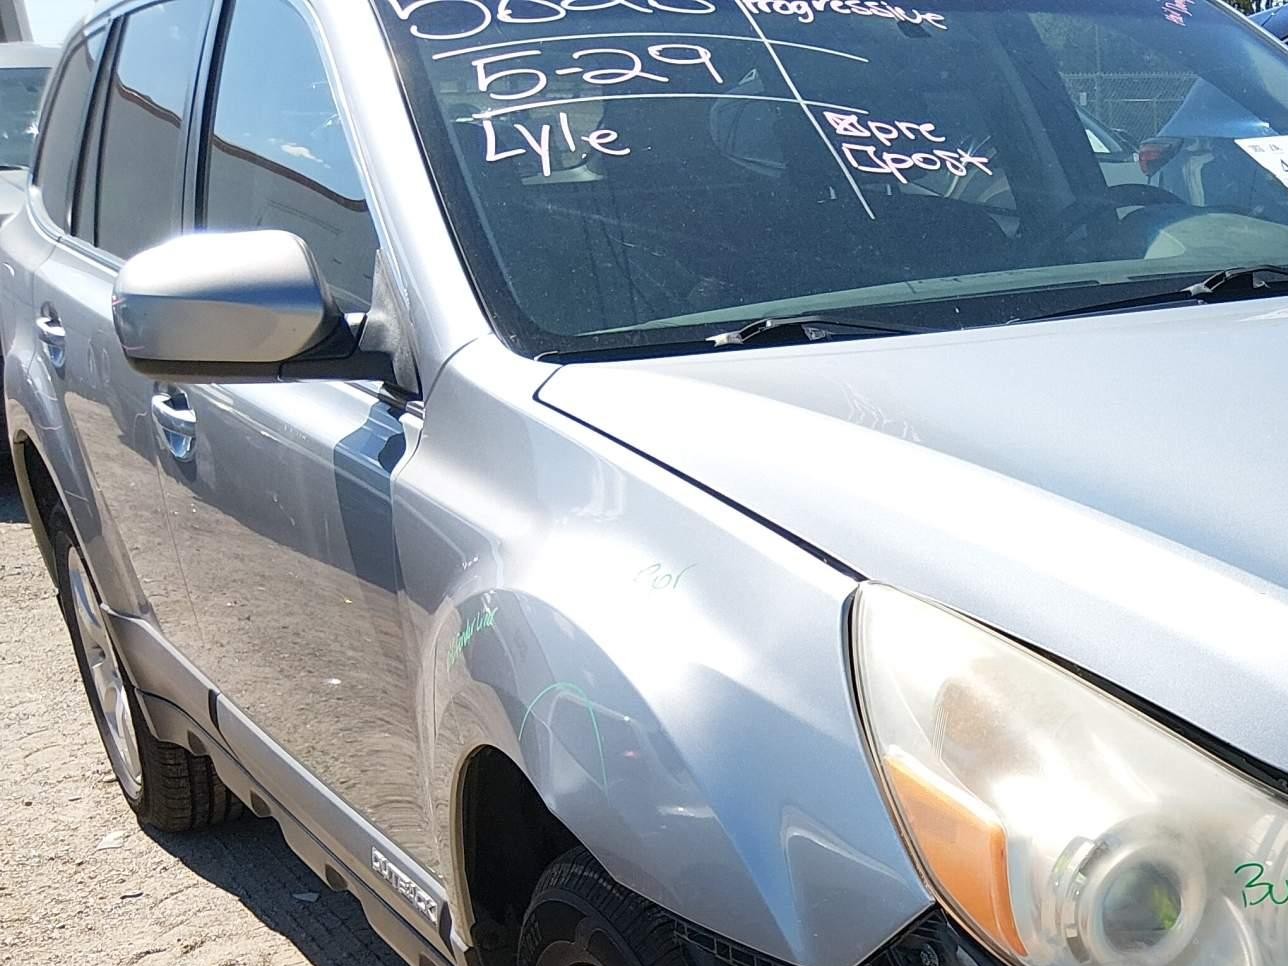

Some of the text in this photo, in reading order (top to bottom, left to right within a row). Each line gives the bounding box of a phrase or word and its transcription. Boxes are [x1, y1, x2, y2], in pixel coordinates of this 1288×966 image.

[472, 43, 723, 100] 5-29
[482, 112, 631, 177] Lyle
[867, 120, 946, 147] pre
[882, 148, 993, 185] post
